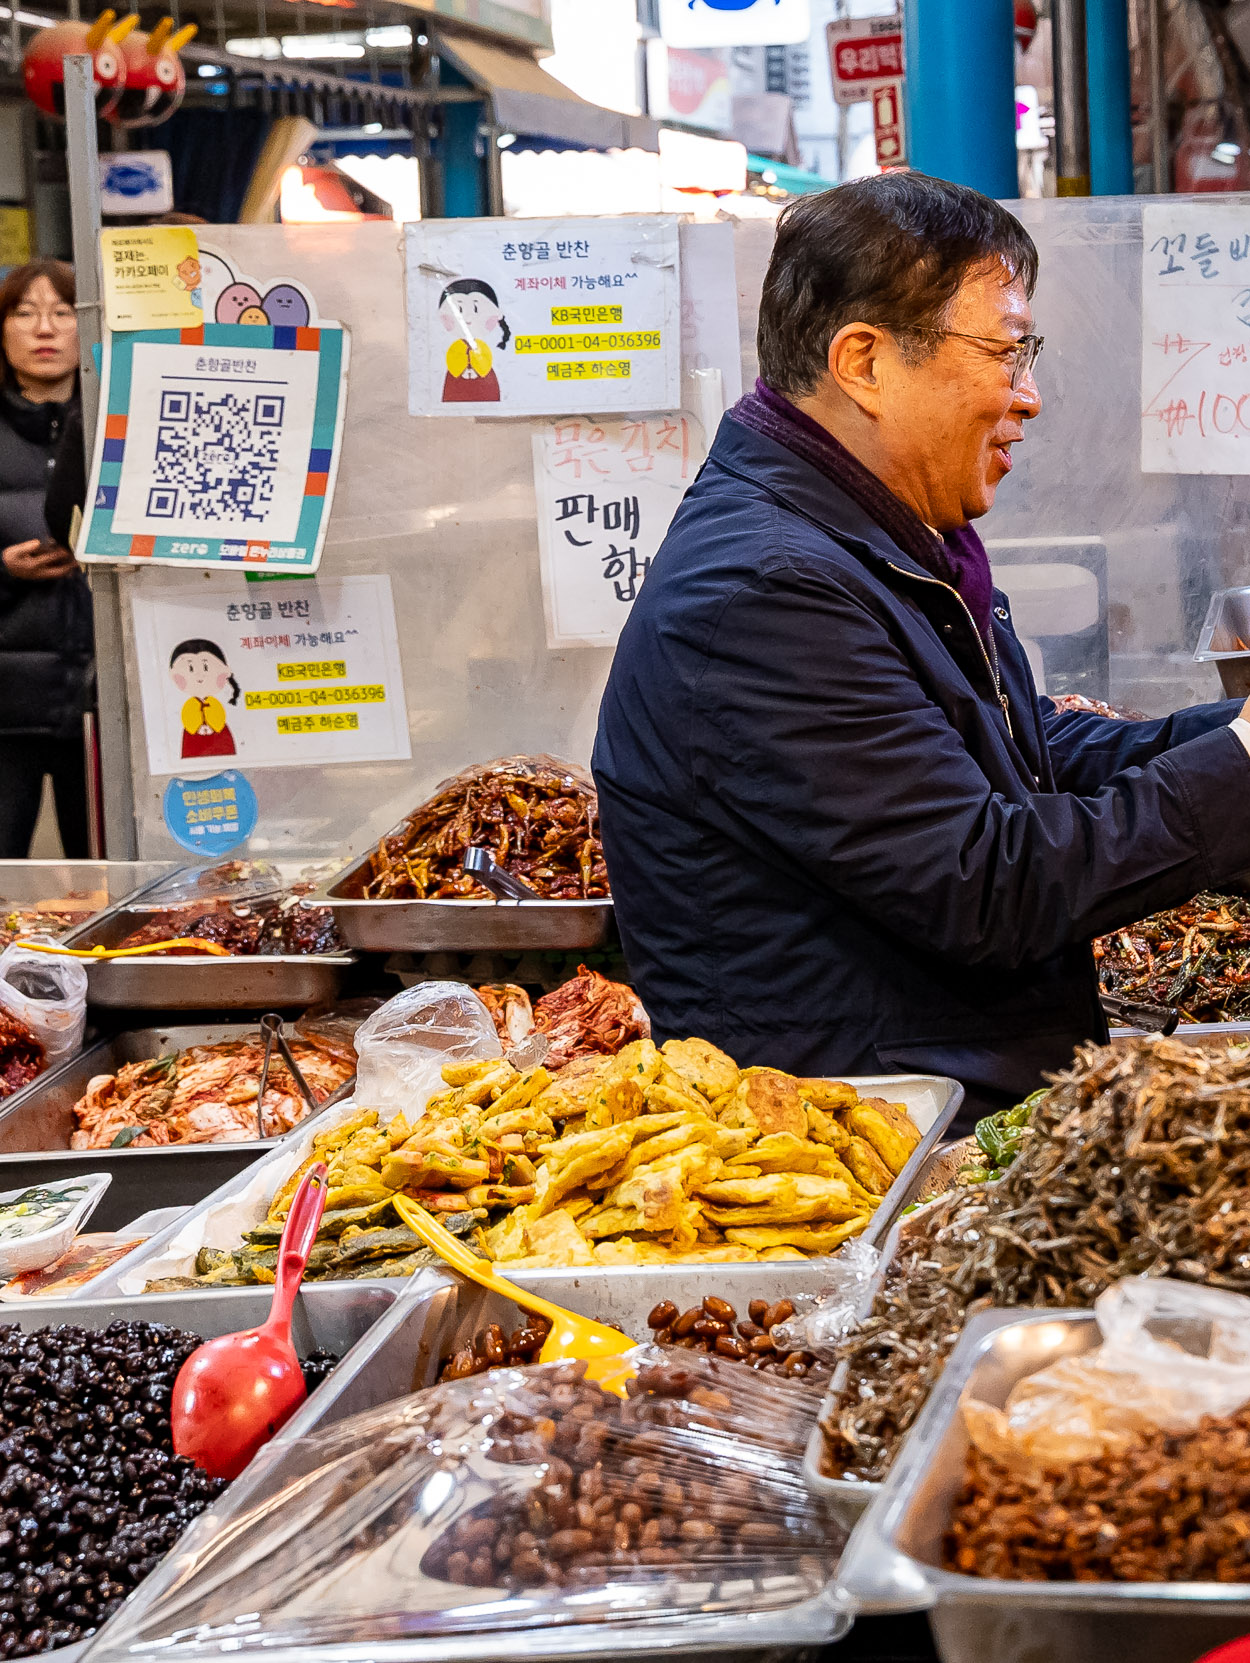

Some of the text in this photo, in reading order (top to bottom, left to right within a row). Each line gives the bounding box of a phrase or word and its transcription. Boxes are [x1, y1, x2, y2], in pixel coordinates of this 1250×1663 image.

[501, 240, 590, 261] 춘향골 반찬
[114, 264, 169, 278] 카카오페이
[514, 277, 567, 291] 계좌이체
[551, 306, 623, 323] KB국민은행
[514, 333, 661, 351] 04-0001-04-036396
[195, 356, 258, 374] 춘향골반찬
[547, 361, 631, 379] 예금주 하순영
[552, 417, 690, 479] 묵은 김치
[555, 494, 640, 547] 판매
[226, 600, 310, 621] 춘향골 반찬
[239, 634, 291, 649] 계좌이체
[277, 660, 346, 679] KB국민은행
[245, 686, 385, 707] 04-0001-04-036396
[277, 712, 359, 733] 예금주 하순영
